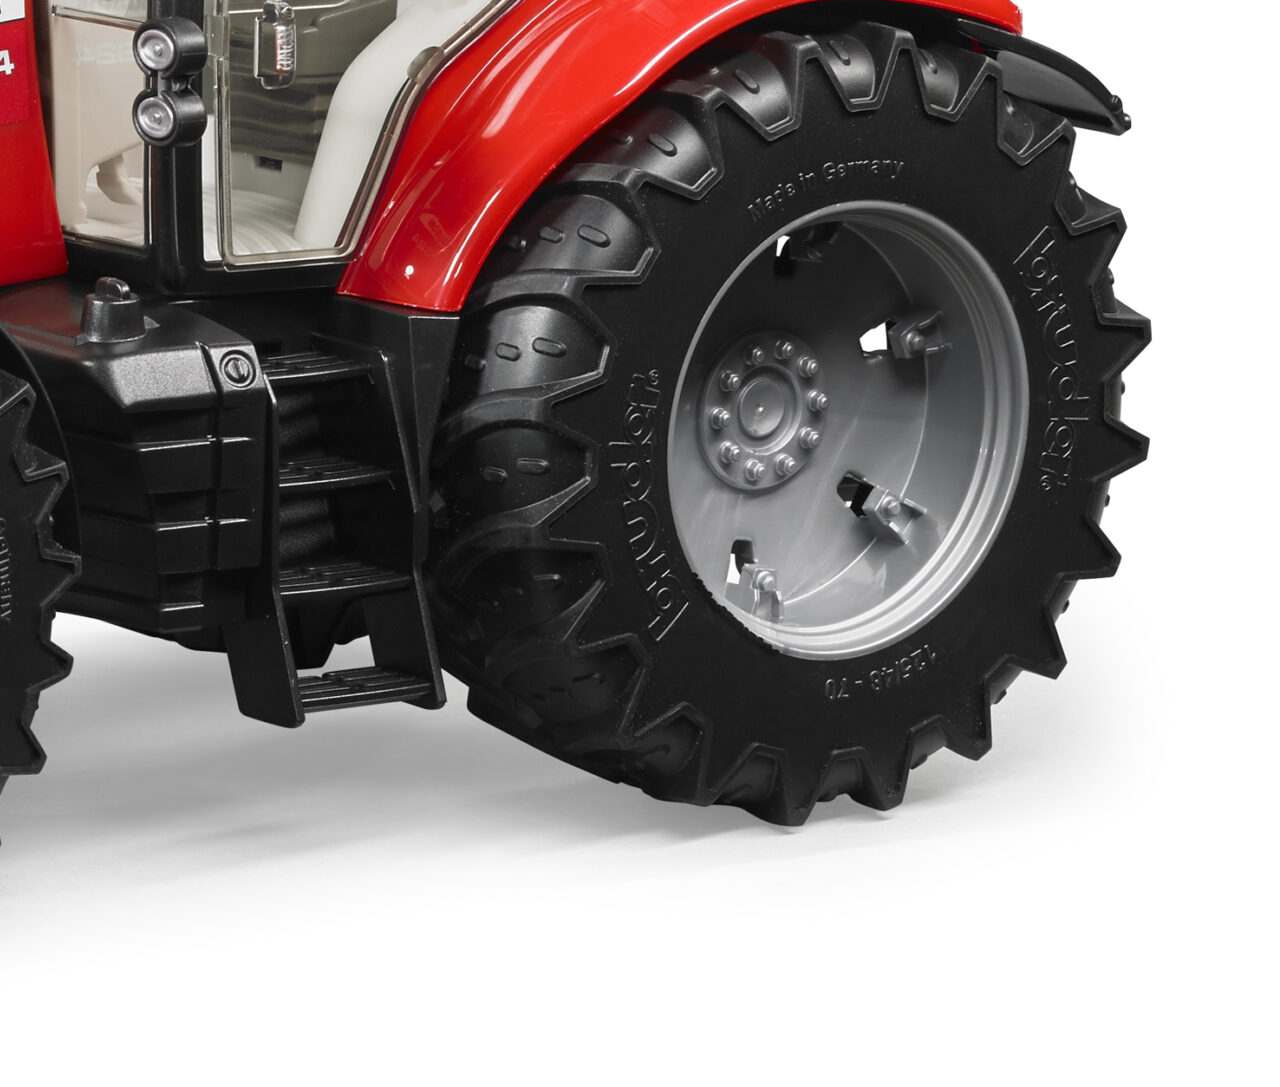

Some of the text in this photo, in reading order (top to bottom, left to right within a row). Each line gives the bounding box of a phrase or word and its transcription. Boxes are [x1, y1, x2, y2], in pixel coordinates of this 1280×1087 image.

[747, 159, 905, 223] Made in Germany
